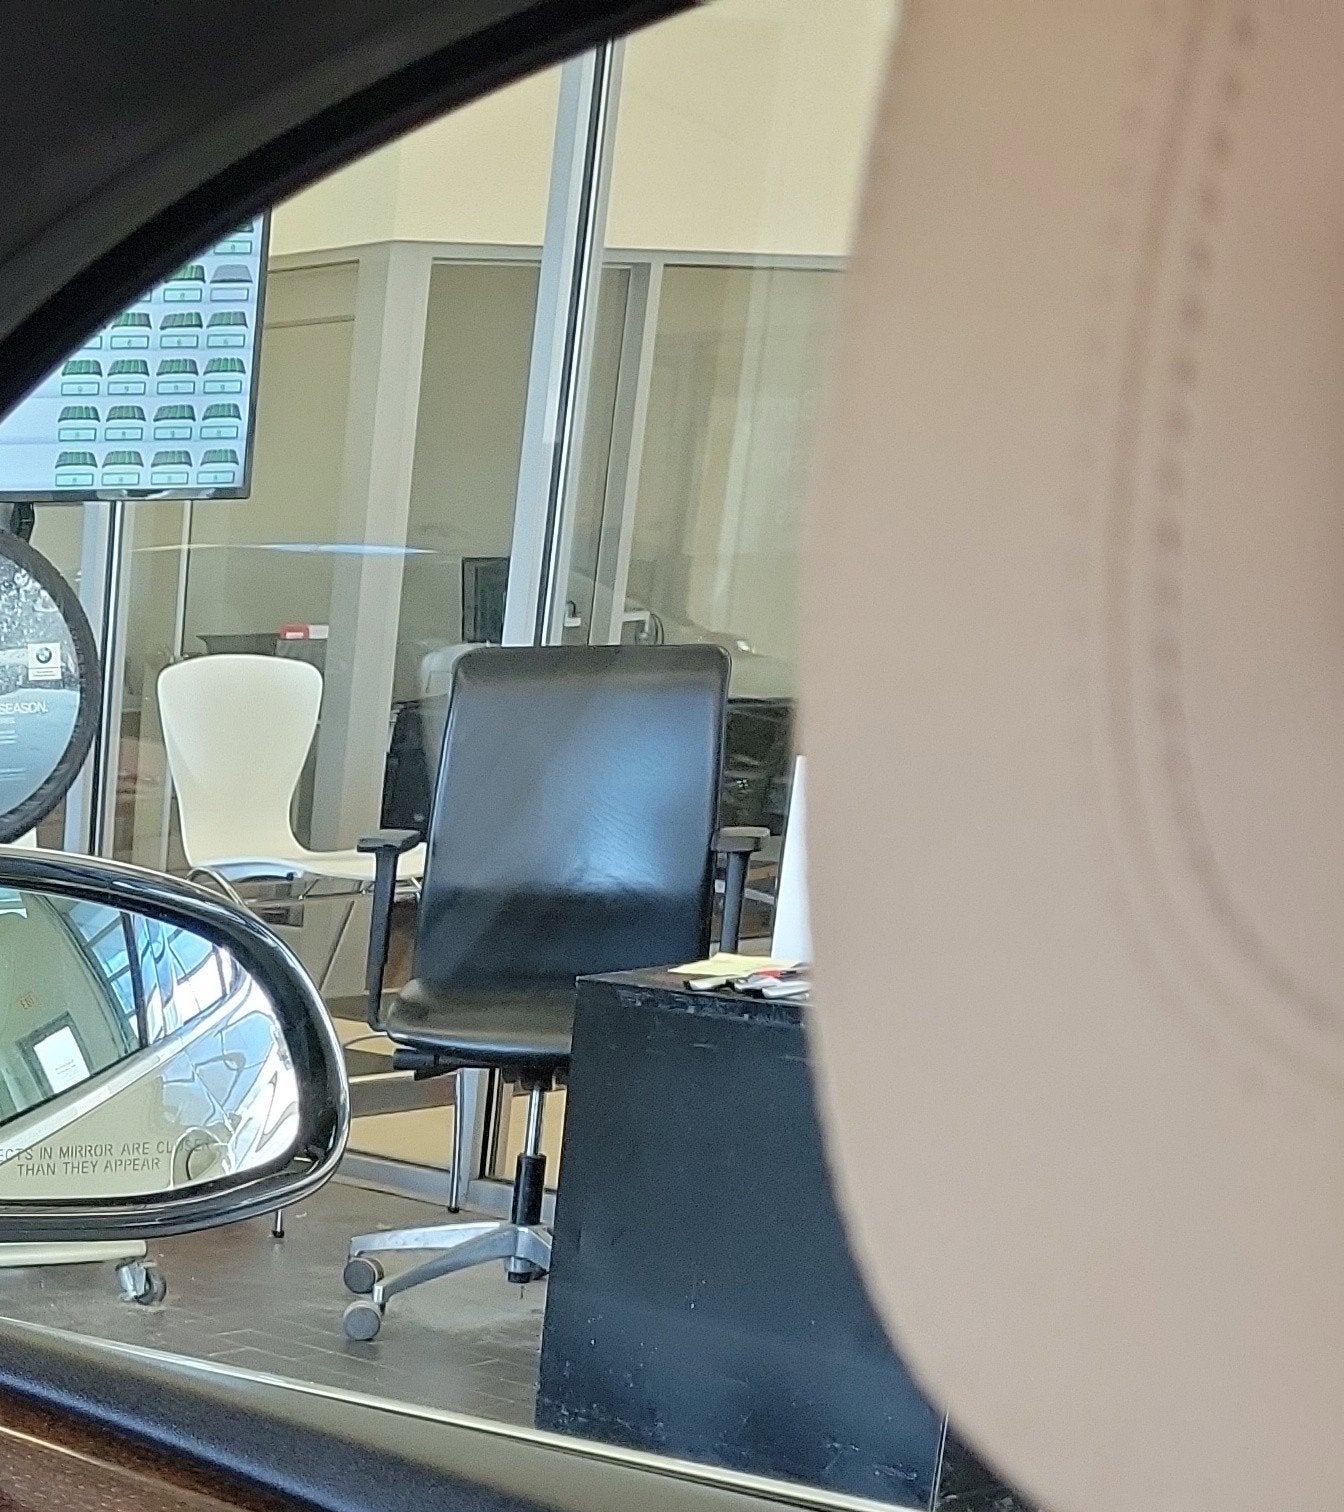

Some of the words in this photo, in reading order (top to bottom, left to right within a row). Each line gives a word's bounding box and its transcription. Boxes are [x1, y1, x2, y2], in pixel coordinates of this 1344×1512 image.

[39, 1147, 53, 1161] IN
[60, 1143, 113, 1159] MIRROR
[120, 1142, 150, 1156] ARE
[17, 1162, 56, 1177] THAN
[62, 1160, 99, 1175] THEY
[103, 1157, 160, 1173] APPEAR
